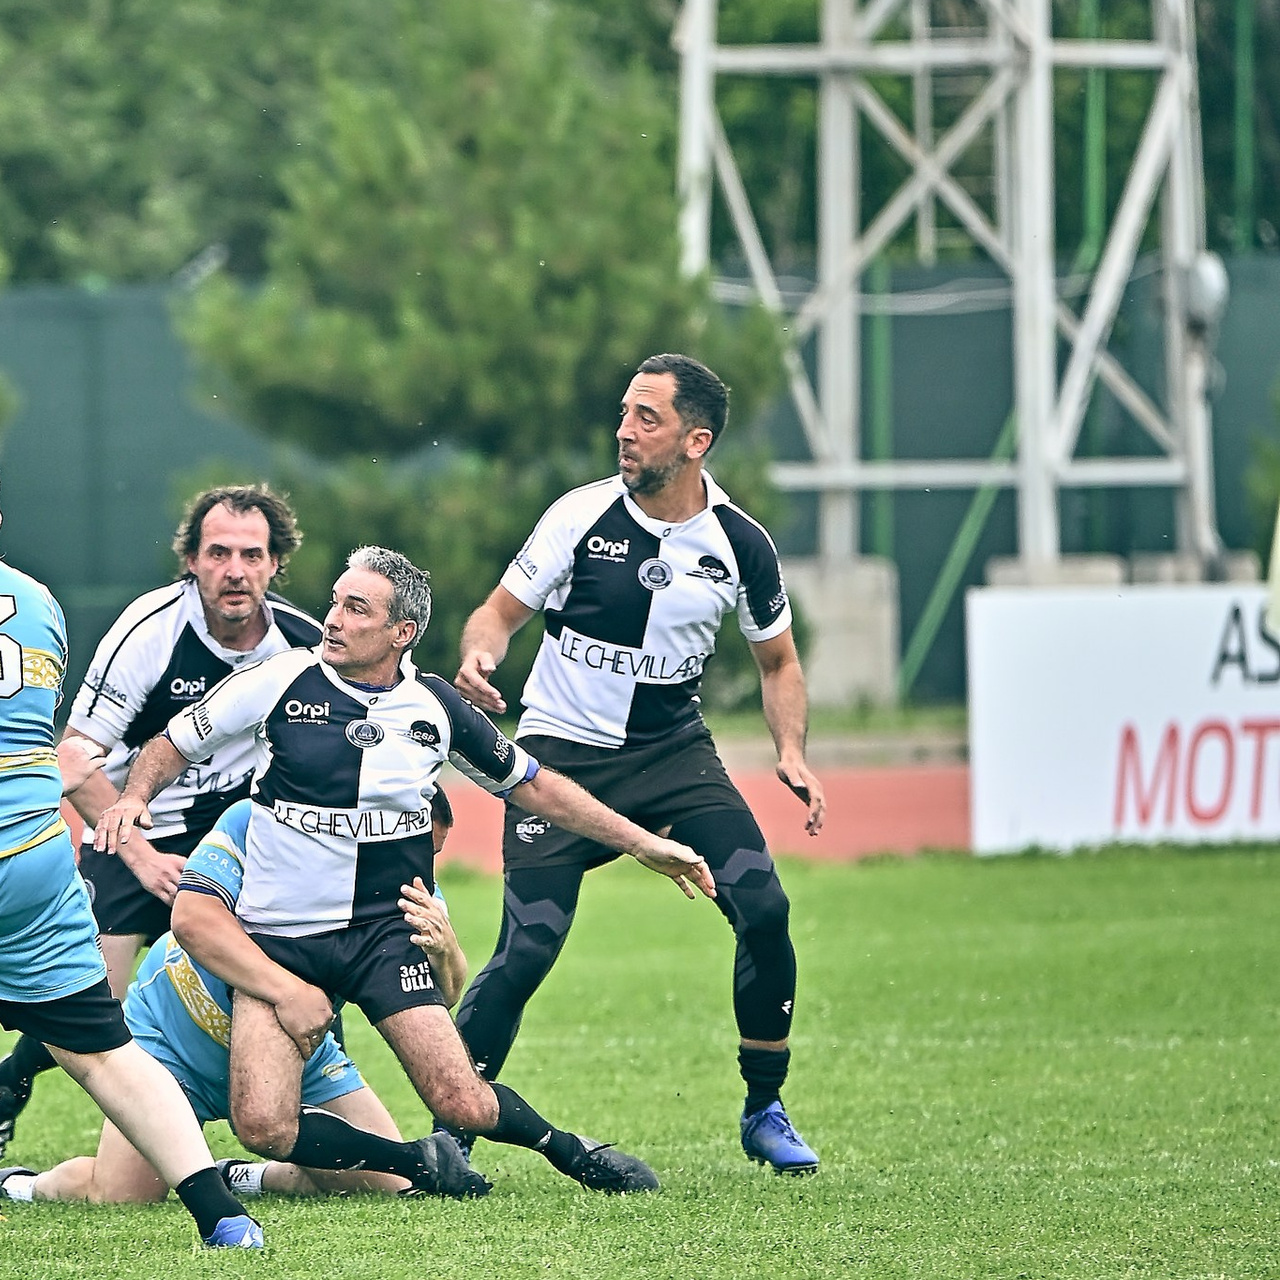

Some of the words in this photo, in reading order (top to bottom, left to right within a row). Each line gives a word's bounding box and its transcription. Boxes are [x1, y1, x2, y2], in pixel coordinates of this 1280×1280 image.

[587, 536, 629, 556] Orpi
[561, 633, 582, 663] LE
[585, 645, 705, 680] CHEVILLAR
[170, 676, 206, 696] Orpi
[285, 699, 331, 719] Orpi
[1114, 719, 1280, 829] MOT
[400, 973, 434, 993] ULLA
